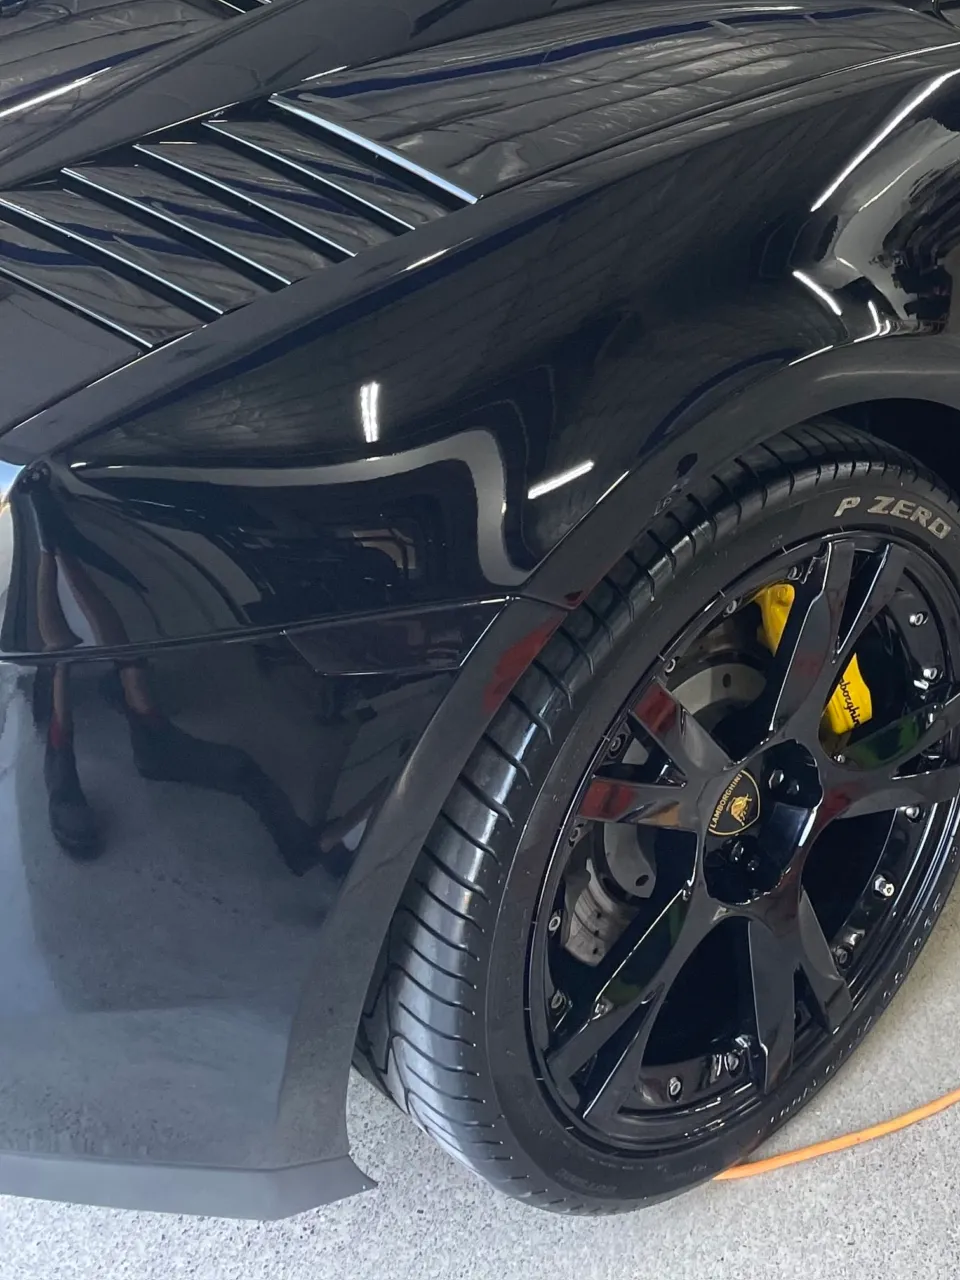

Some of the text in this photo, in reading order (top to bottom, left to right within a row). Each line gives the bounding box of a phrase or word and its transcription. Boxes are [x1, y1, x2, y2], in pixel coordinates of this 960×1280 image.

[834, 495, 952, 540] P ZERO
[709, 773, 743, 829] LAMBORGHINI
